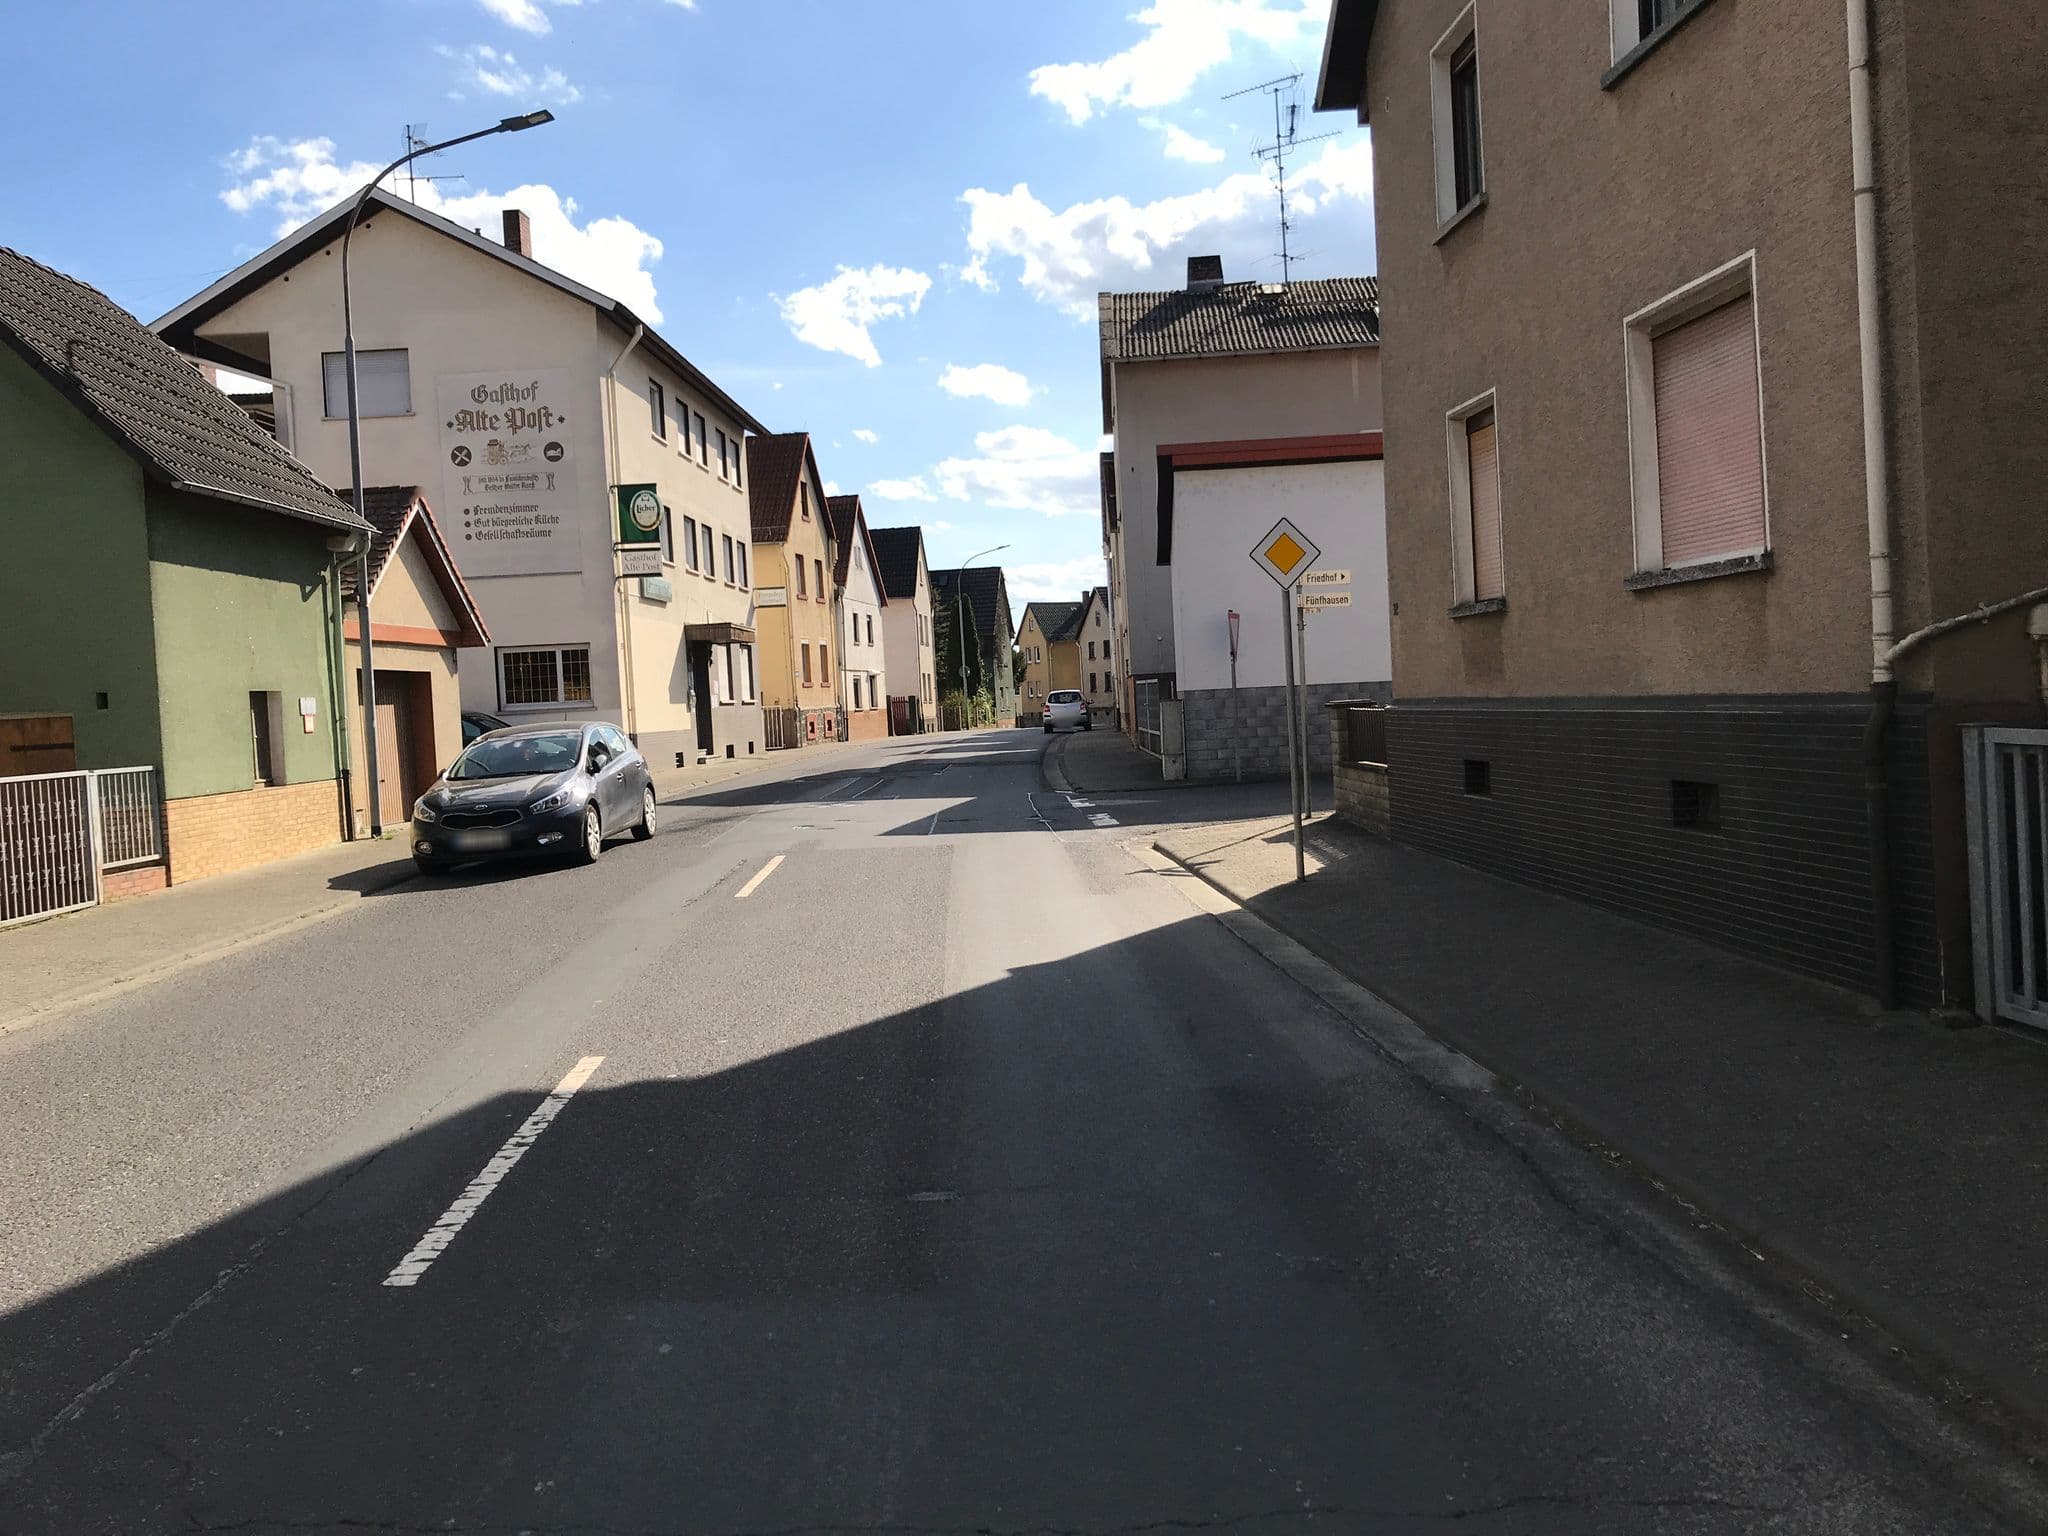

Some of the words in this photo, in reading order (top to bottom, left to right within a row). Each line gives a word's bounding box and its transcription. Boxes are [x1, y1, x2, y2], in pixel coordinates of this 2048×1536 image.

[471, 381, 539, 405] Gasthof
[454, 409, 501, 433] Alte
[503, 406, 554, 436] Post
[473, 503, 539, 516] Fremdenzimmer
[636, 504, 656, 514] Licher
[474, 517, 490, 528] Gut
[491, 516, 533, 528] bürgerliche
[534, 514, 560, 526] Küche
[624, 553, 657, 562] Gasthof
[623, 563, 640, 572] Alte
[642, 563, 661, 571] Post
[1306, 573, 1338, 583] Friedhof
[1305, 595, 1349, 605] Fünfhausen
